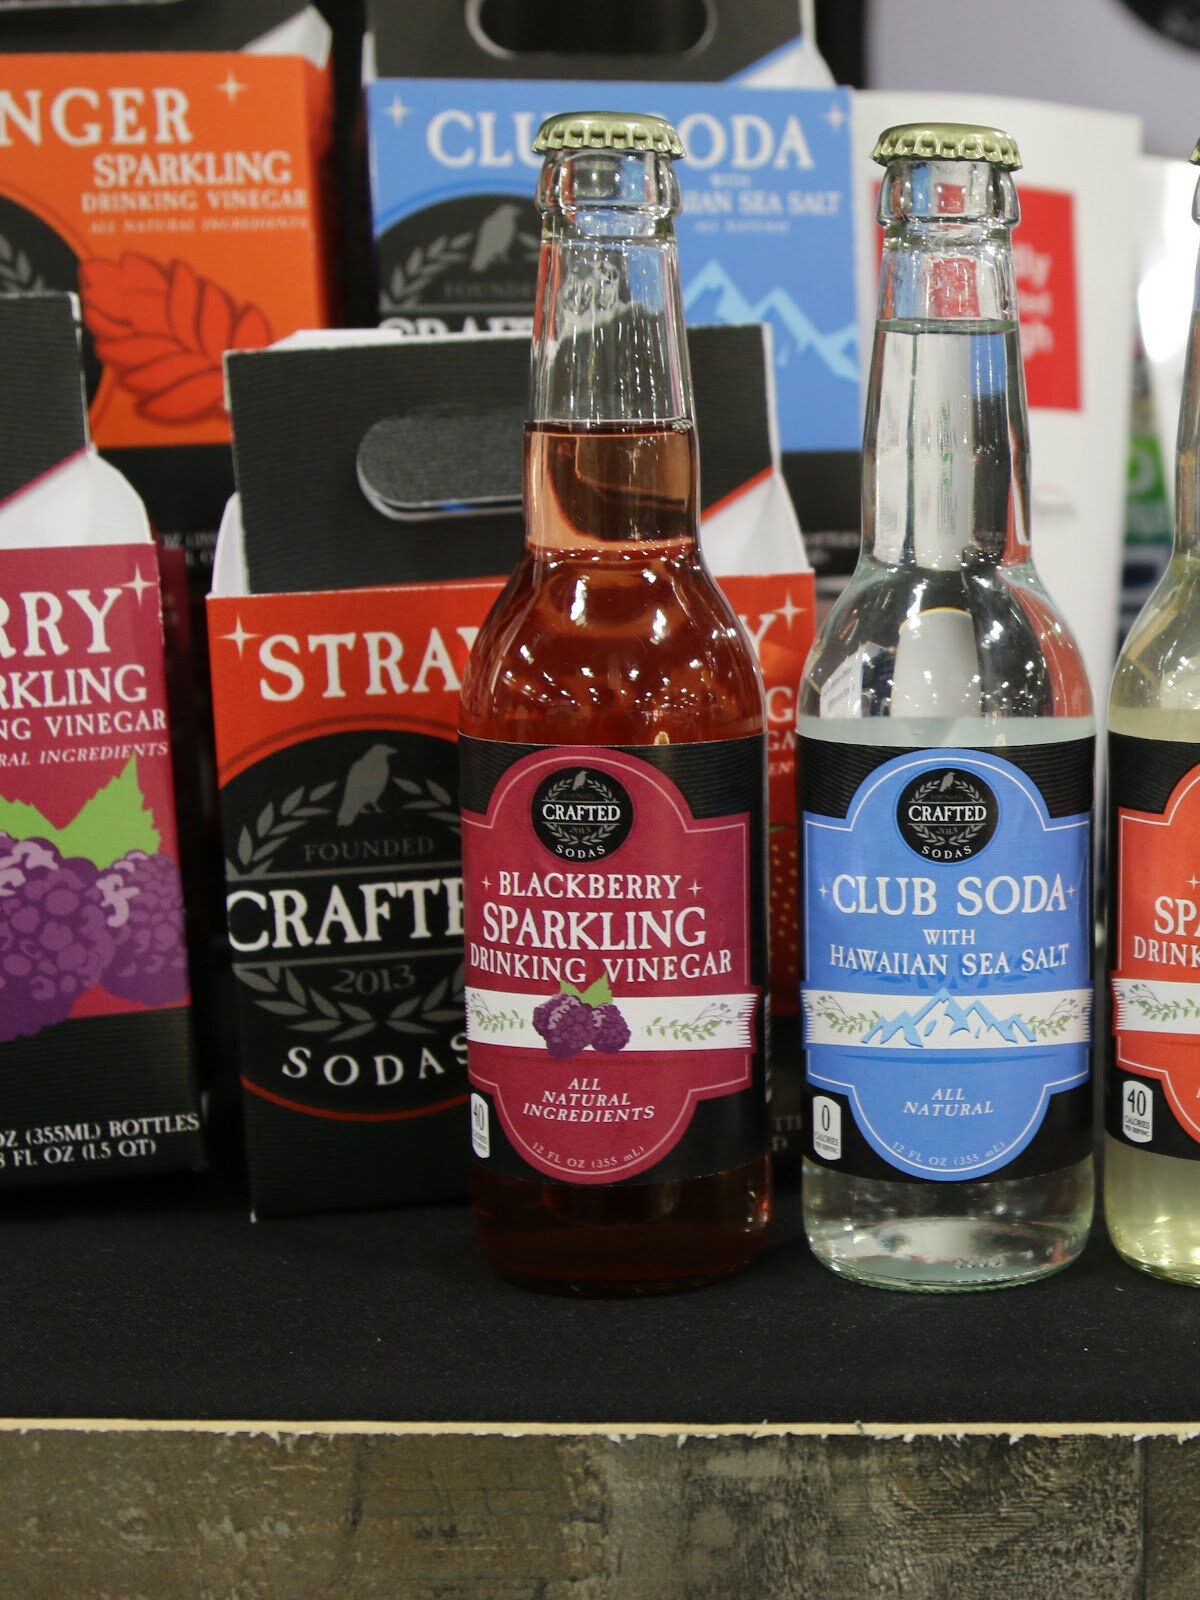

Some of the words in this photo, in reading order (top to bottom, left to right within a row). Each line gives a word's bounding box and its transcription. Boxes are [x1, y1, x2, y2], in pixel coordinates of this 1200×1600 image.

[426, 109, 540, 168] CLU
[664, 113, 815, 170] ODA
[93, 150, 292, 188] SPARKLING
[80, 191, 198, 213] DRINKING
[206, 188, 308, 209] VINEGAR
[44, 708, 167, 738] VINEGAR
[40, 742, 168, 765] INGREDIENTS
[542, 804, 621, 821] CRAFTED
[908, 805, 987, 822] CRAFTED
[303, 836, 434, 863] FOUNDED
[555, 844, 606, 859] SODAS
[921, 845, 972, 859] SODAS
[498, 871, 682, 900] BLACKBERRY
[832, 874, 937, 916] CLUB
[956, 873, 1067, 917] SODA
[226, 878, 465, 952] CRAFTE
[483, 902, 706, 951] SPARKLING
[923, 929, 976, 945] WITH
[470, 943, 587, 983] DRINKING
[602, 949, 732, 983] VINEGAR
[830, 944, 948, 976] HAWAIIAN
[962, 952, 1010, 976] SEA
[1021, 943, 1069, 972] SALT
[331, 965, 416, 996] 2013
[568, 1078, 601, 1091] ALL
[931, 1088, 965, 1101] ALL
[542, 1090, 631, 1107] NATURAL
[903, 1101, 994, 1117] NATURAL
[1127, 1089, 1146, 1117] 40
[522, 1103, 655, 1123] INGREDIENTS
[821, 1104, 830, 1132] 0
[1125, 1115, 1150, 1130] CALORIES
[26, 1123, 101, 1147] (355ML)
[109, 1113, 200, 1138] BOTTLES
[44, 1146, 74, 1164] OZ
[118, 1139, 157, 1158] QT)
[532, 1142, 543, 1154] 12
[548, 1152, 561, 1164] FL
[567, 1158, 586, 1169] OZ
[591, 1156, 618, 1169] (355
[893, 1141, 905, 1153] 12
[908, 1151, 922, 1163] FL
[928, 1156, 948, 1167] OZ
[953, 1154, 979, 1167] (355
